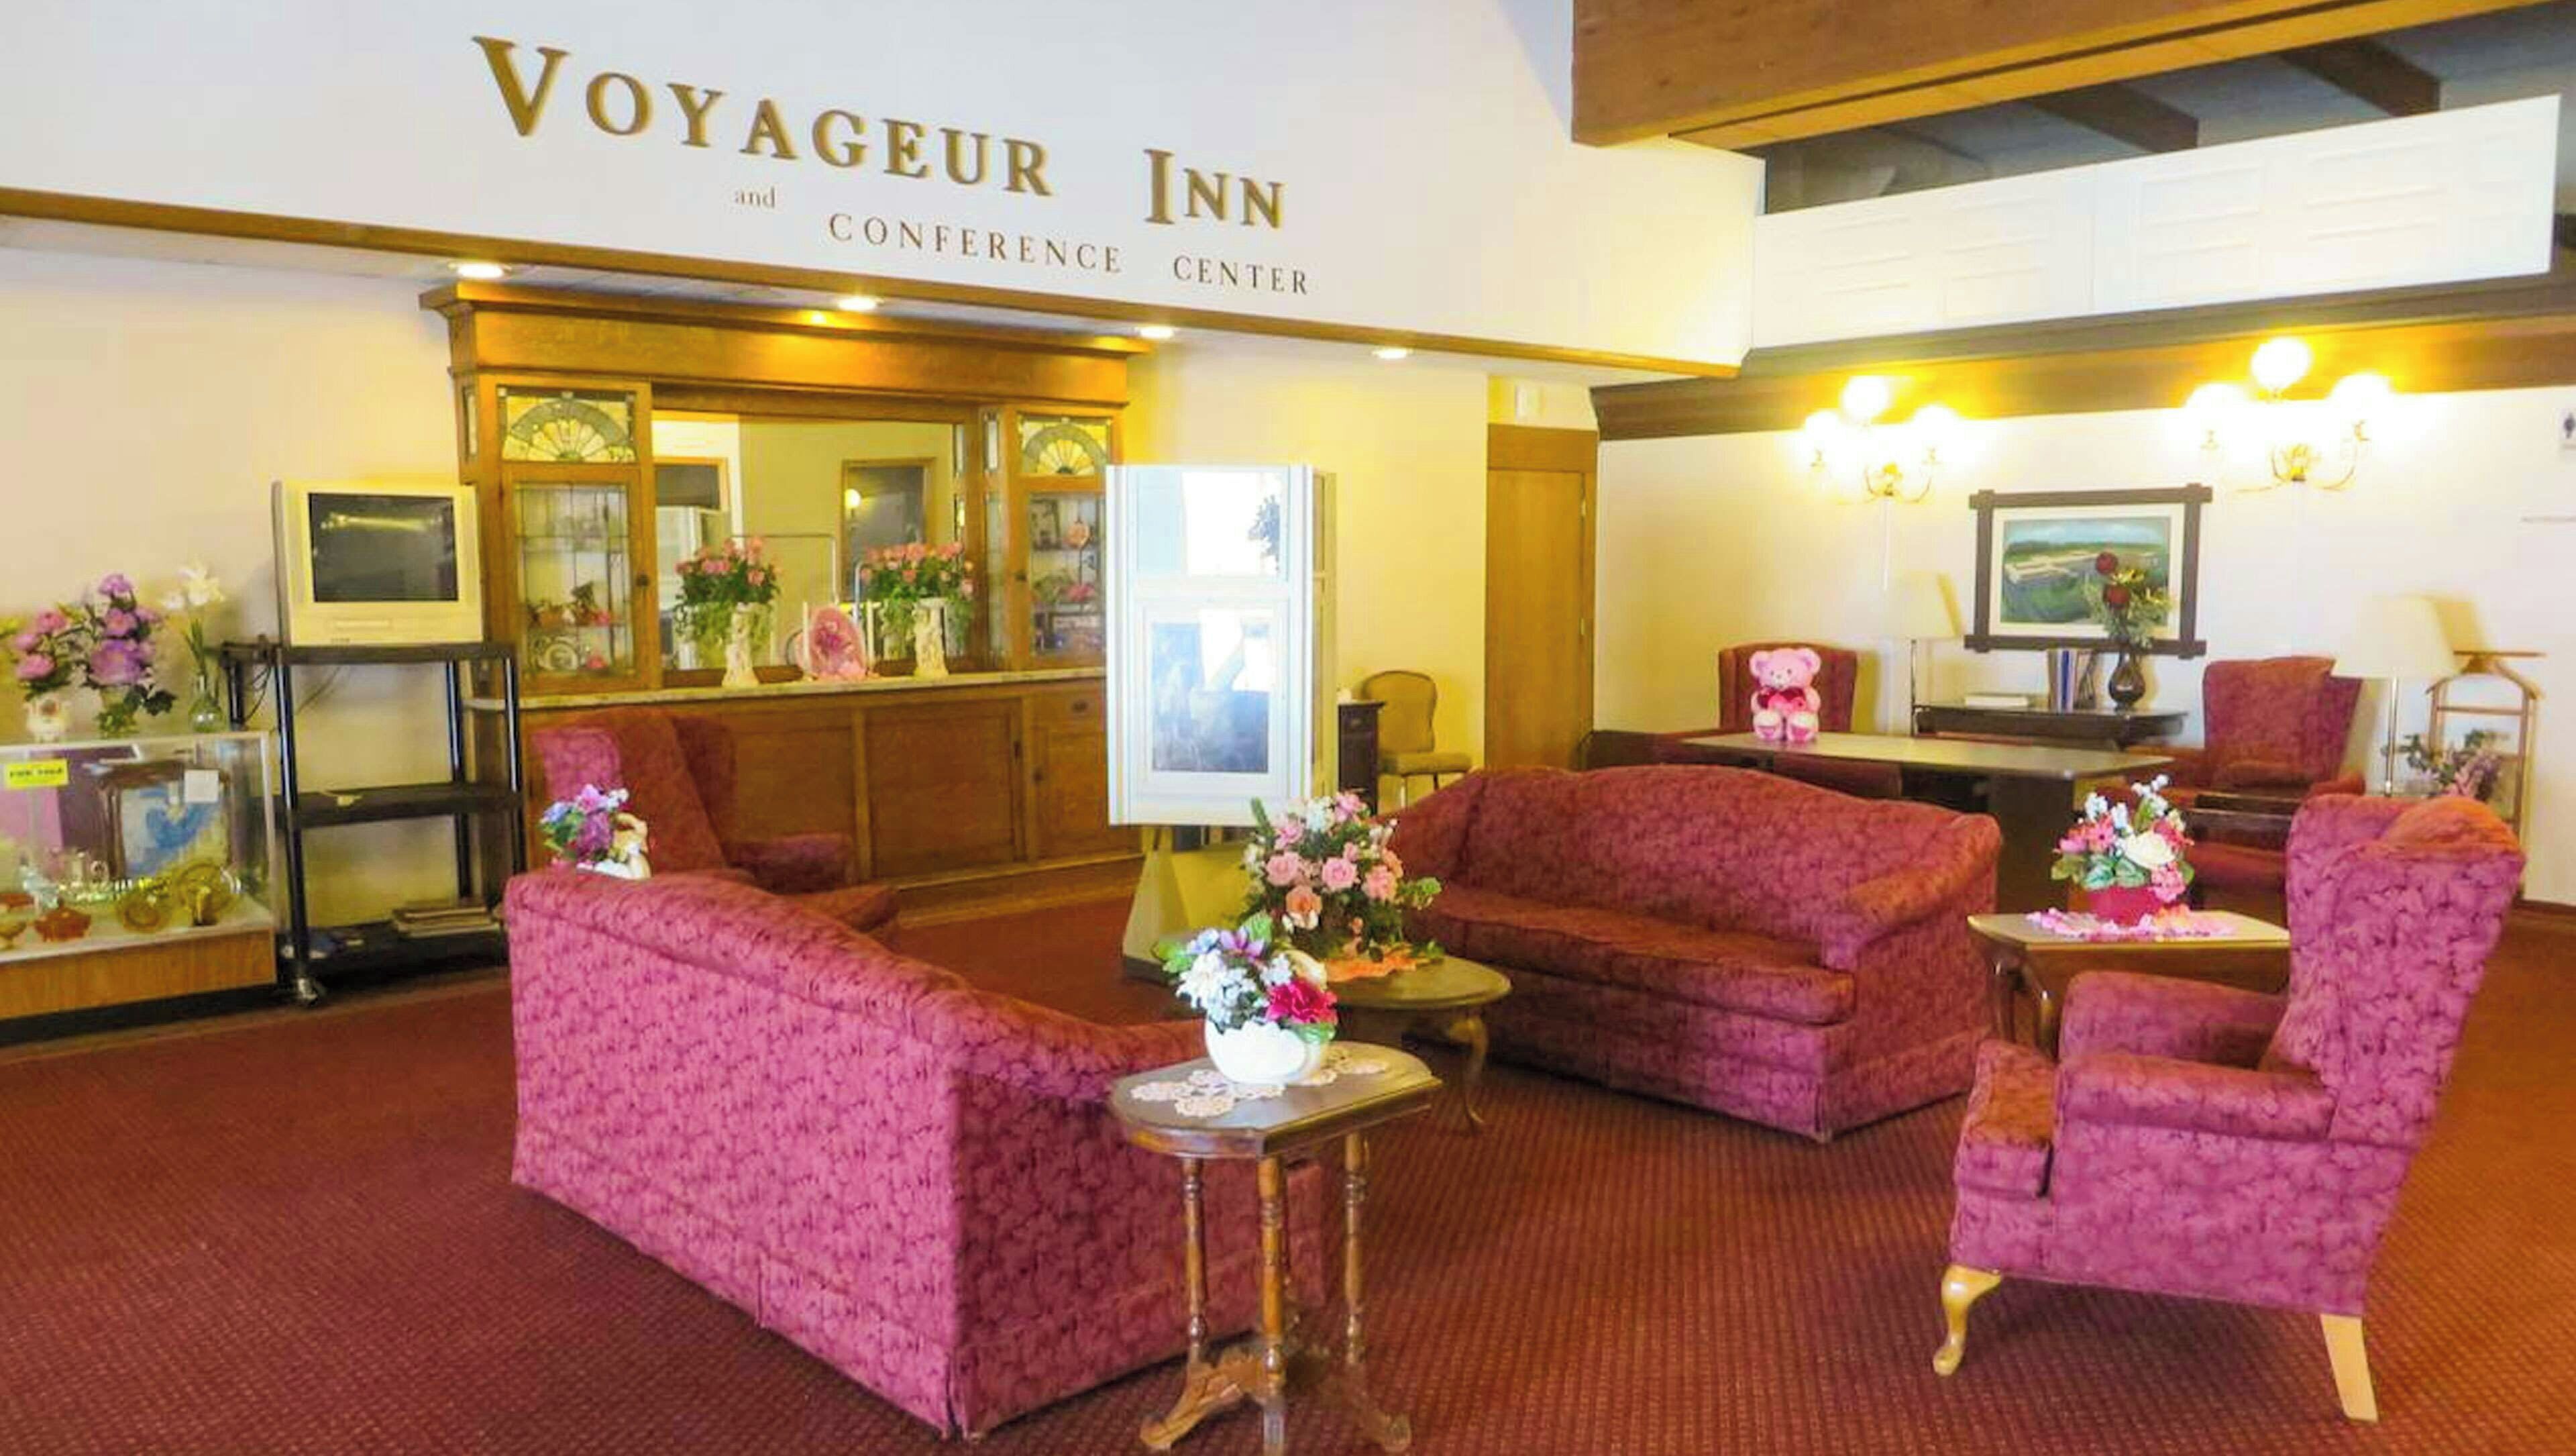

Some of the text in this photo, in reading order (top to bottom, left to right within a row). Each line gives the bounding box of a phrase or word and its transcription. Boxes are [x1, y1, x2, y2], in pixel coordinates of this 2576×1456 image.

[472, 36, 1286, 231] VOYAGEUR INN
[735, 187, 775, 209] and
[829, 215, 1307, 295] CONFERENCE CENTER
